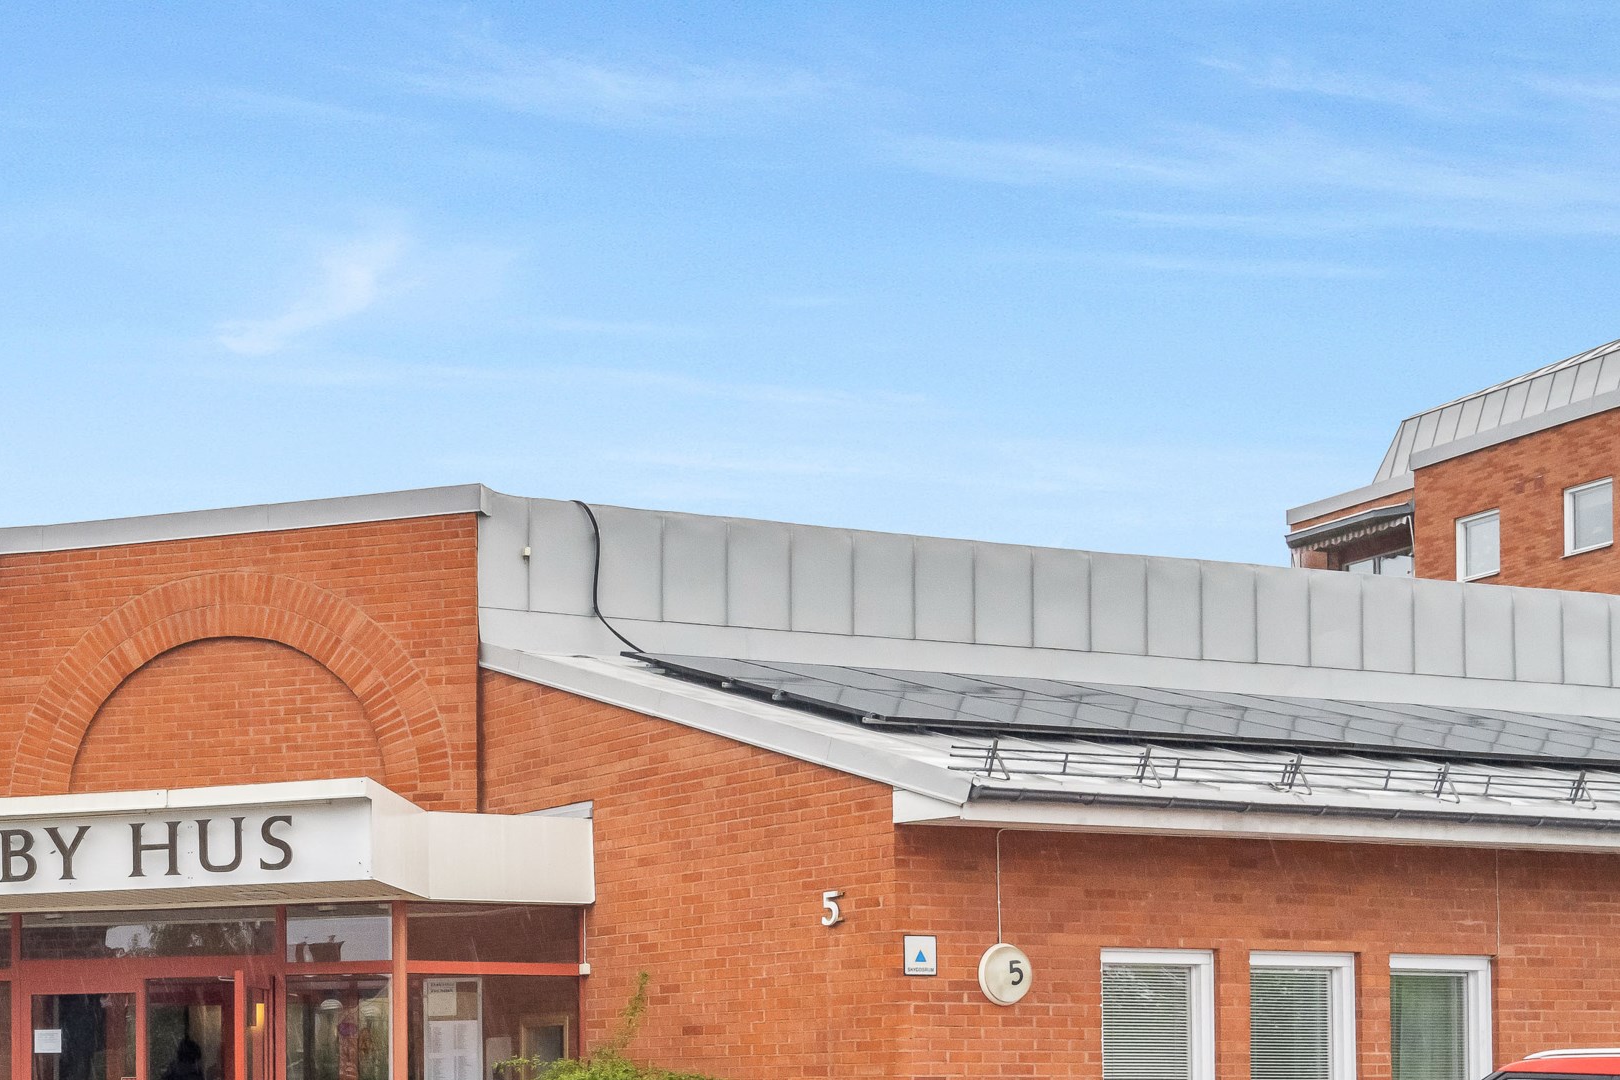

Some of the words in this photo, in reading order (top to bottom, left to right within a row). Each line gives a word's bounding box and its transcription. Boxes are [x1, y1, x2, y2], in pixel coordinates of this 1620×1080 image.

[128, 815, 293, 877] HUS
[821, 890, 840, 926] 5
[1009, 960, 1024, 986] 5
